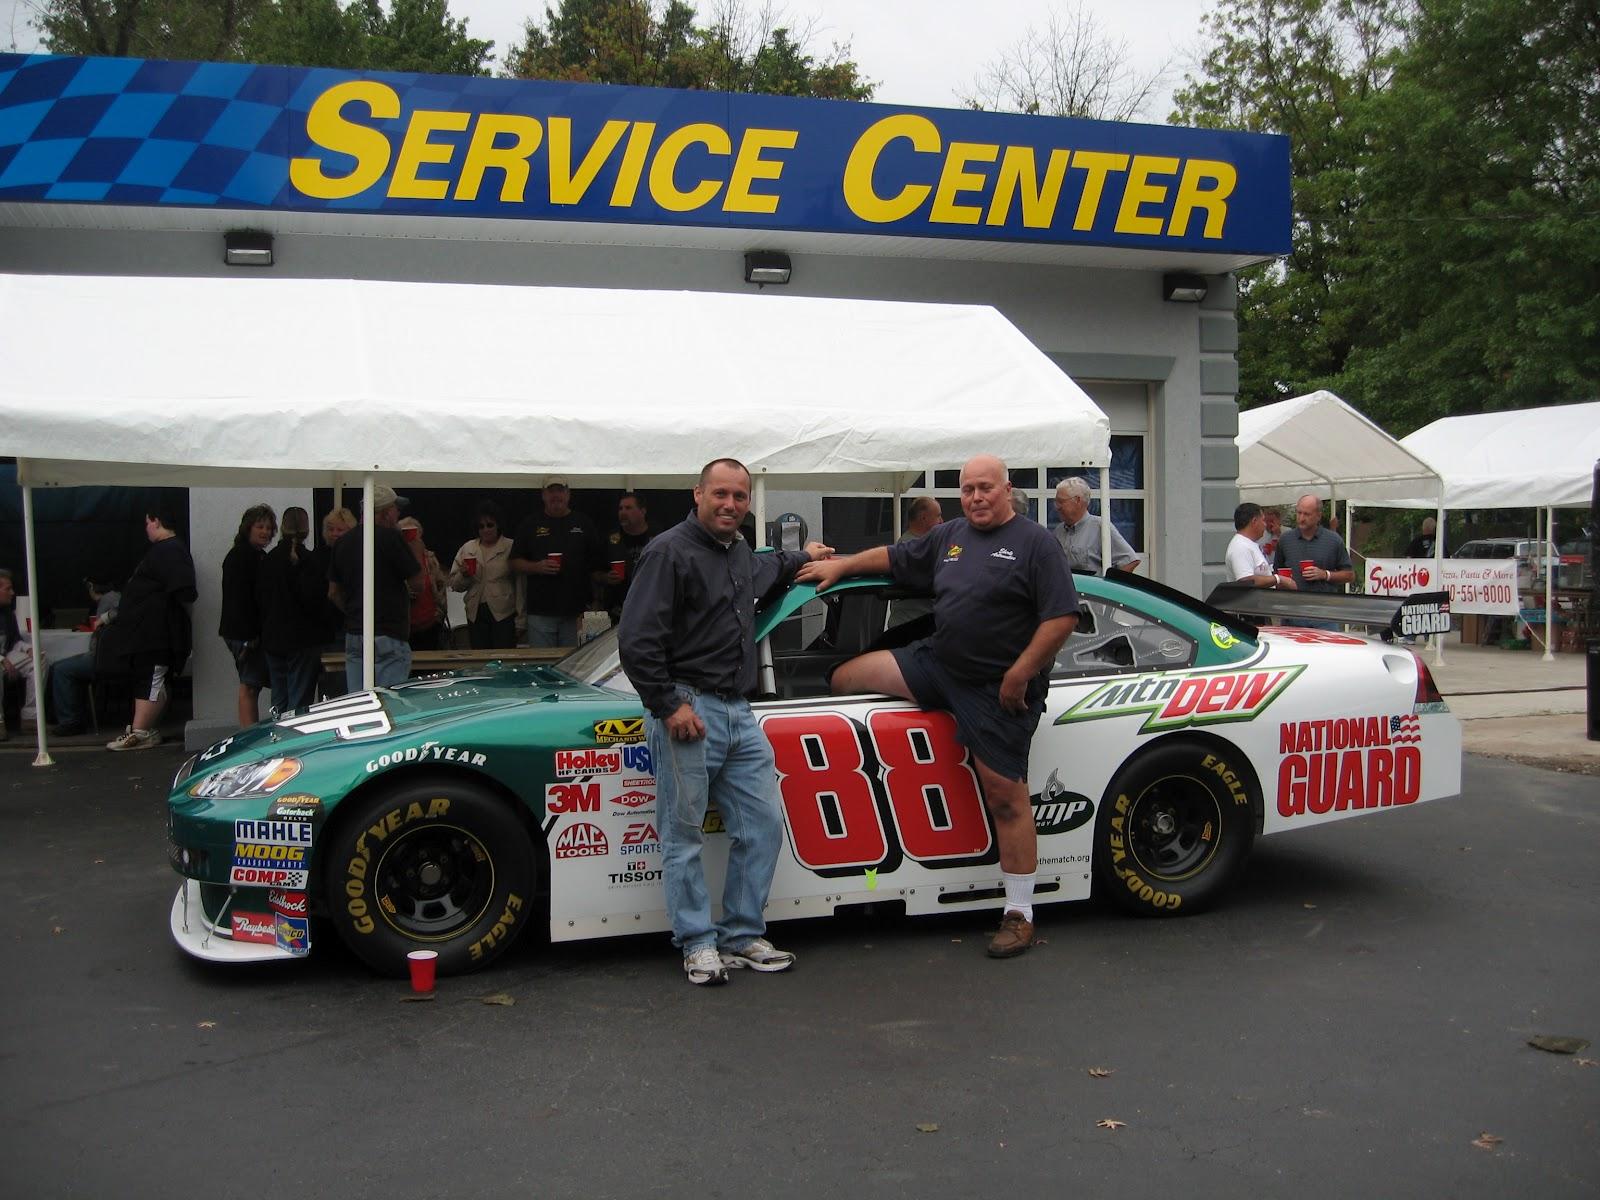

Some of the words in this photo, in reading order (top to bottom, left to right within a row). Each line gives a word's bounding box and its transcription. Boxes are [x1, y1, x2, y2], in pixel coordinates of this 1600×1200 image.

[289, 80, 799, 214] SERVICE
[842, 113, 1237, 240] CENTER
[1460, 569, 1481, 579] Pasta
[1401, 603, 1439, 615] NATIONAL
[1401, 612, 1451, 635] GUARD
[1279, 715, 1392, 754] NATIONAL
[366, 741, 488, 773] GOODYEAR
[557, 751, 620, 773] Holley
[759, 708, 995, 872] 88
[1201, 754, 1248, 805] EAGLE
[1276, 746, 1422, 818] GUARD
[276, 796, 320, 804] GOODYEAR
[547, 783, 601, 814] 3M
[276, 806, 315, 817] Gatorback
[236, 820, 312, 842] MAHLE
[622, 823, 659, 845] EA
[235, 843, 305, 861] MOOG
[557, 846, 607, 857] TOOLS
[1109, 793, 1182, 910] GOODYEAR
[237, 858, 271, 867] CHASSIS
[276, 861, 302, 869] PARTS
[346, 798, 451, 935] GOODYEAR
[233, 869, 288, 883] COMP
[608, 870, 663, 883] TISSOT
[468, 893, 523, 961] EAGLE
